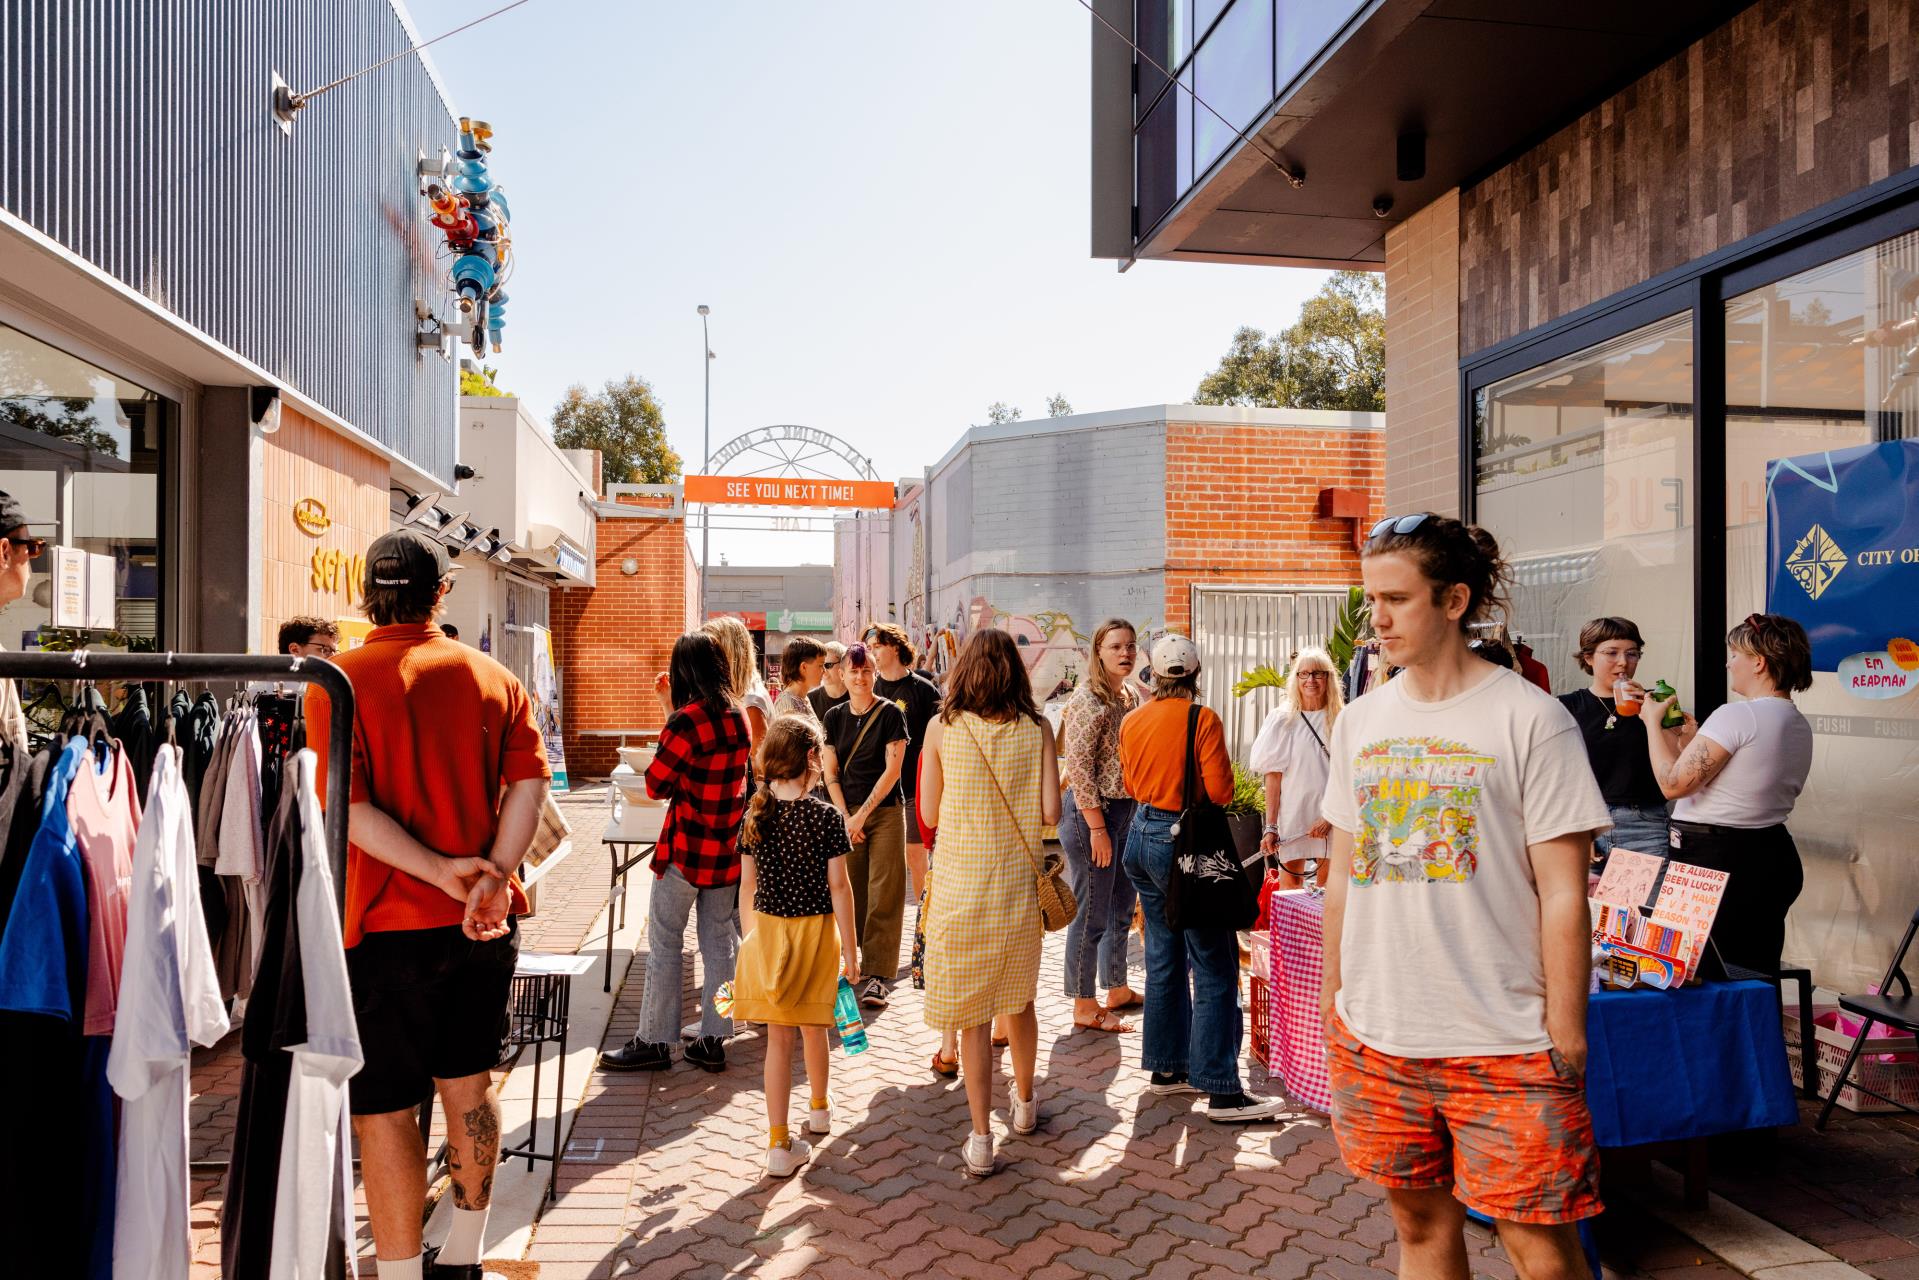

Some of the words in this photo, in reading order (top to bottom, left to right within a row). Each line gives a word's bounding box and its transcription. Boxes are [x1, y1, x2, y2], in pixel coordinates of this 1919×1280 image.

[726, 482, 750, 498] SEE
[755, 483, 780, 499] YOU
[784, 484, 816, 500] NEXT
[821, 485, 854, 501] TIME!
[1857, 550, 1895, 566] CITY
[1864, 657, 1884, 670] EM
[1852, 674, 1906, 688] READMAN
[1816, 717, 1851, 733] FUSHI
[1874, 720, 1913, 737] FUSHI
[1405, 754, 1497, 787] STREET
[1379, 777, 1429, 800] BAND
[1669, 862, 1687, 873] I'VE
[1687, 867, 1726, 881] ALWAYS
[1664, 873, 1689, 887] BEEN
[1690, 880, 1722, 893] LUCKY
[1660, 885, 1674, 895] SO
[1692, 893, 1718, 906] HAVE
[1653, 908, 1690, 926] REASON
[1696, 920, 1709, 930] TO
